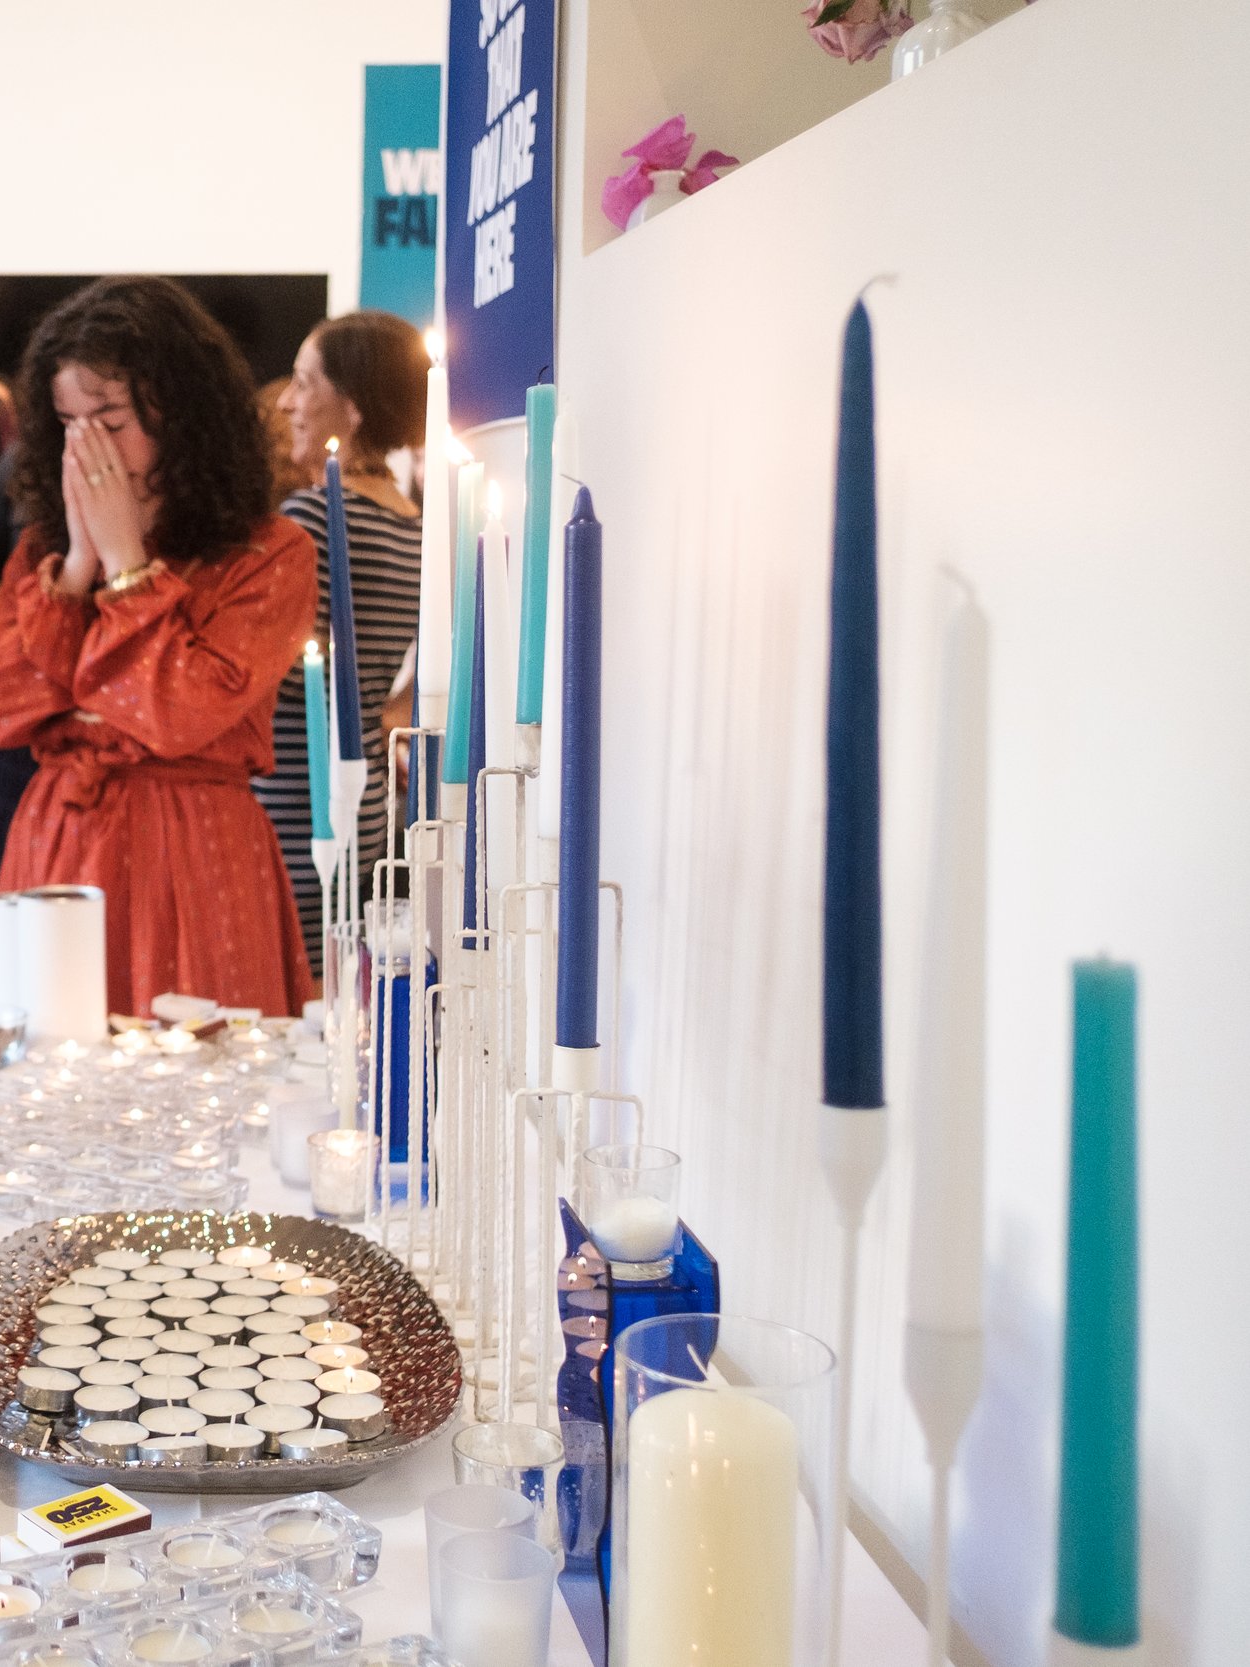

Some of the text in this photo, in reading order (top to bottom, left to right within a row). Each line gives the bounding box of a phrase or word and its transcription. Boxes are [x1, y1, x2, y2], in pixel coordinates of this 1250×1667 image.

[497, 88, 538, 203] ARE
[374, 197, 437, 247] FA
[473, 200, 516, 309] HERE
[46, 1496, 111, 1524] 250
[62, 1506, 118, 1529] SHABBAT
